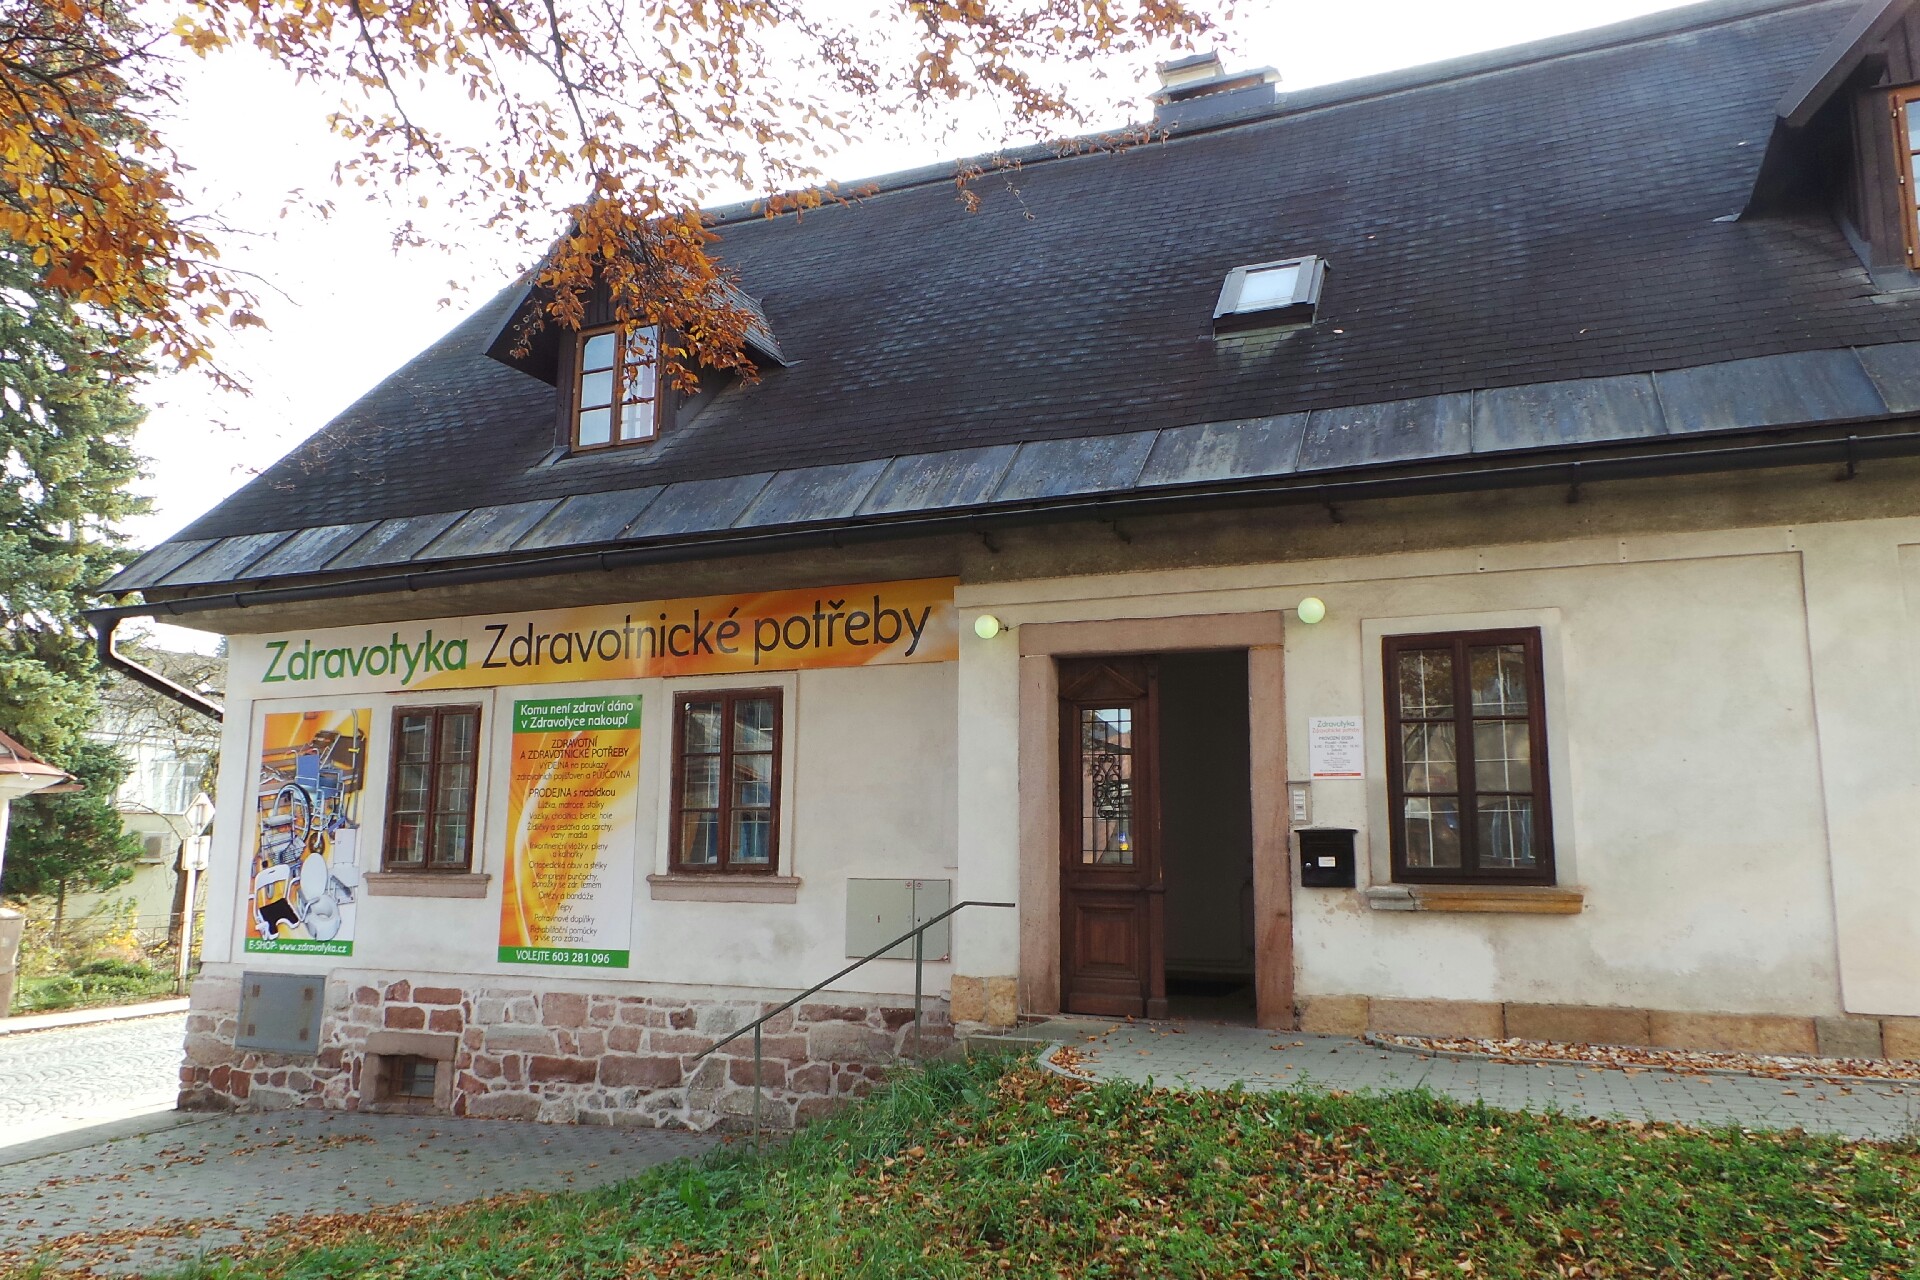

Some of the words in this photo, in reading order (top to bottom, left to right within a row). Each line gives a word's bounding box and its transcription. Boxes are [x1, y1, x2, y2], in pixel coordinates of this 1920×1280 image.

[481, 606, 740, 669] Zdravotnické
[754, 596, 932, 665] potřeby
[262, 630, 468, 685] Zdravotyka
[521, 704, 548, 716] Komu
[550, 702, 570, 714] není
[573, 701, 605, 714] zdraví
[607, 700, 634, 712] dáno
[521, 720, 528, 729] v
[530, 716, 586, 729] Zdravotyce
[588, 713, 629, 728] nakoupí
[551, 735, 599, 749] ZDRAVOTNÍ
[520, 751, 527, 760] A
[527, 747, 590, 760] ZDRAVOTNICKÉ
[591, 745, 630, 759] POTŘEBY
[540, 759, 569, 770] VÝDEJNA
[580, 761, 609, 771] poukazy
[592, 769, 631, 779] PŮJČOVNA
[529, 788, 571, 798] PRODEJNA
[573, 790, 578, 798] s
[579, 787, 616, 797] nabídkou
[581, 822, 590, 831] do
[249, 940, 278, 950] E-SHOP:
[279, 942, 347, 955] www.zdravotyka.cz
[516, 950, 550, 962] VOLEJTE
[552, 952, 569, 962] 603
[572, 953, 589, 963] 281
[592, 953, 609, 964] 096
